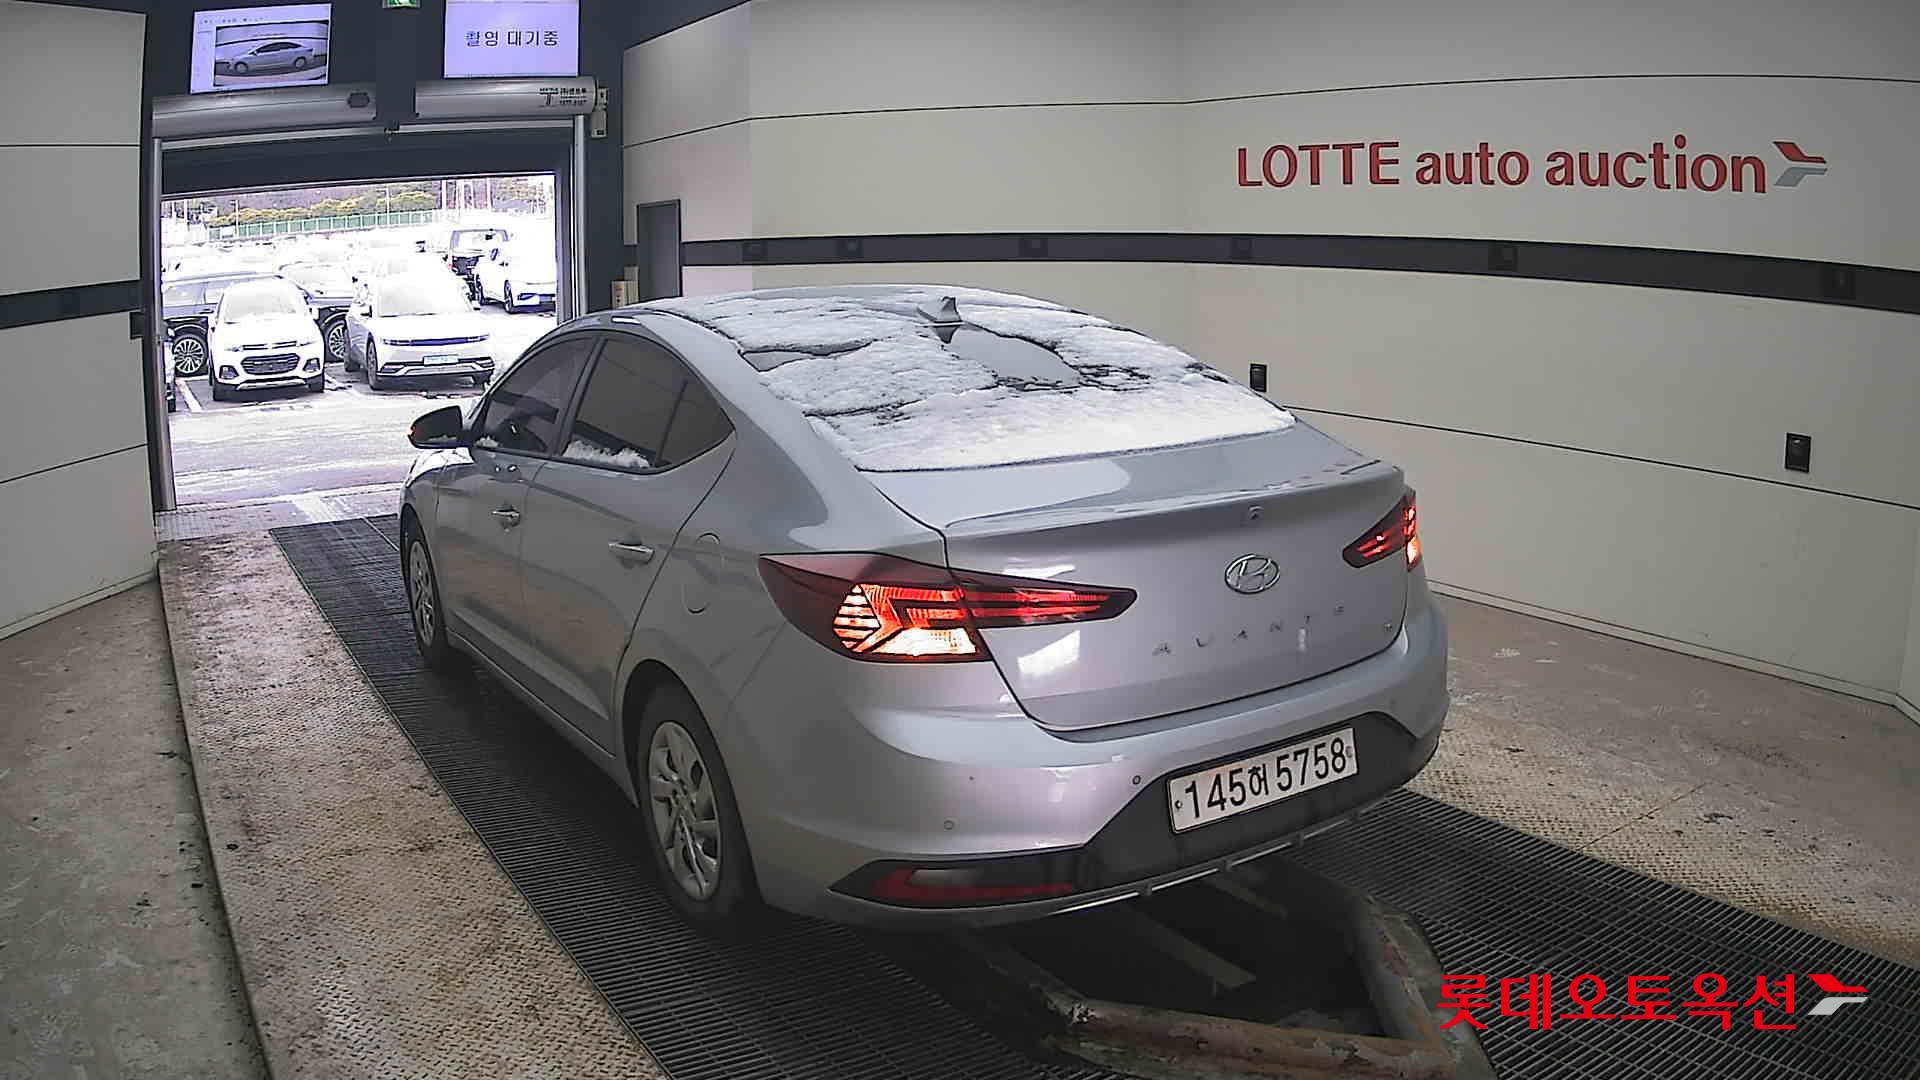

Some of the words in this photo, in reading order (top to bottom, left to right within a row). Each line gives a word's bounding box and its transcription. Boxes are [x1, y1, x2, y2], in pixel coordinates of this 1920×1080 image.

[507, 30, 559, 47] 대기중
[1237, 142, 1399, 188] LOTTE
[1415, 142, 1530, 186] auto
[1545, 134, 1767, 194] auction
[1184, 763, 1269, 818] 145허
[1275, 737, 1347, 792] 5758
